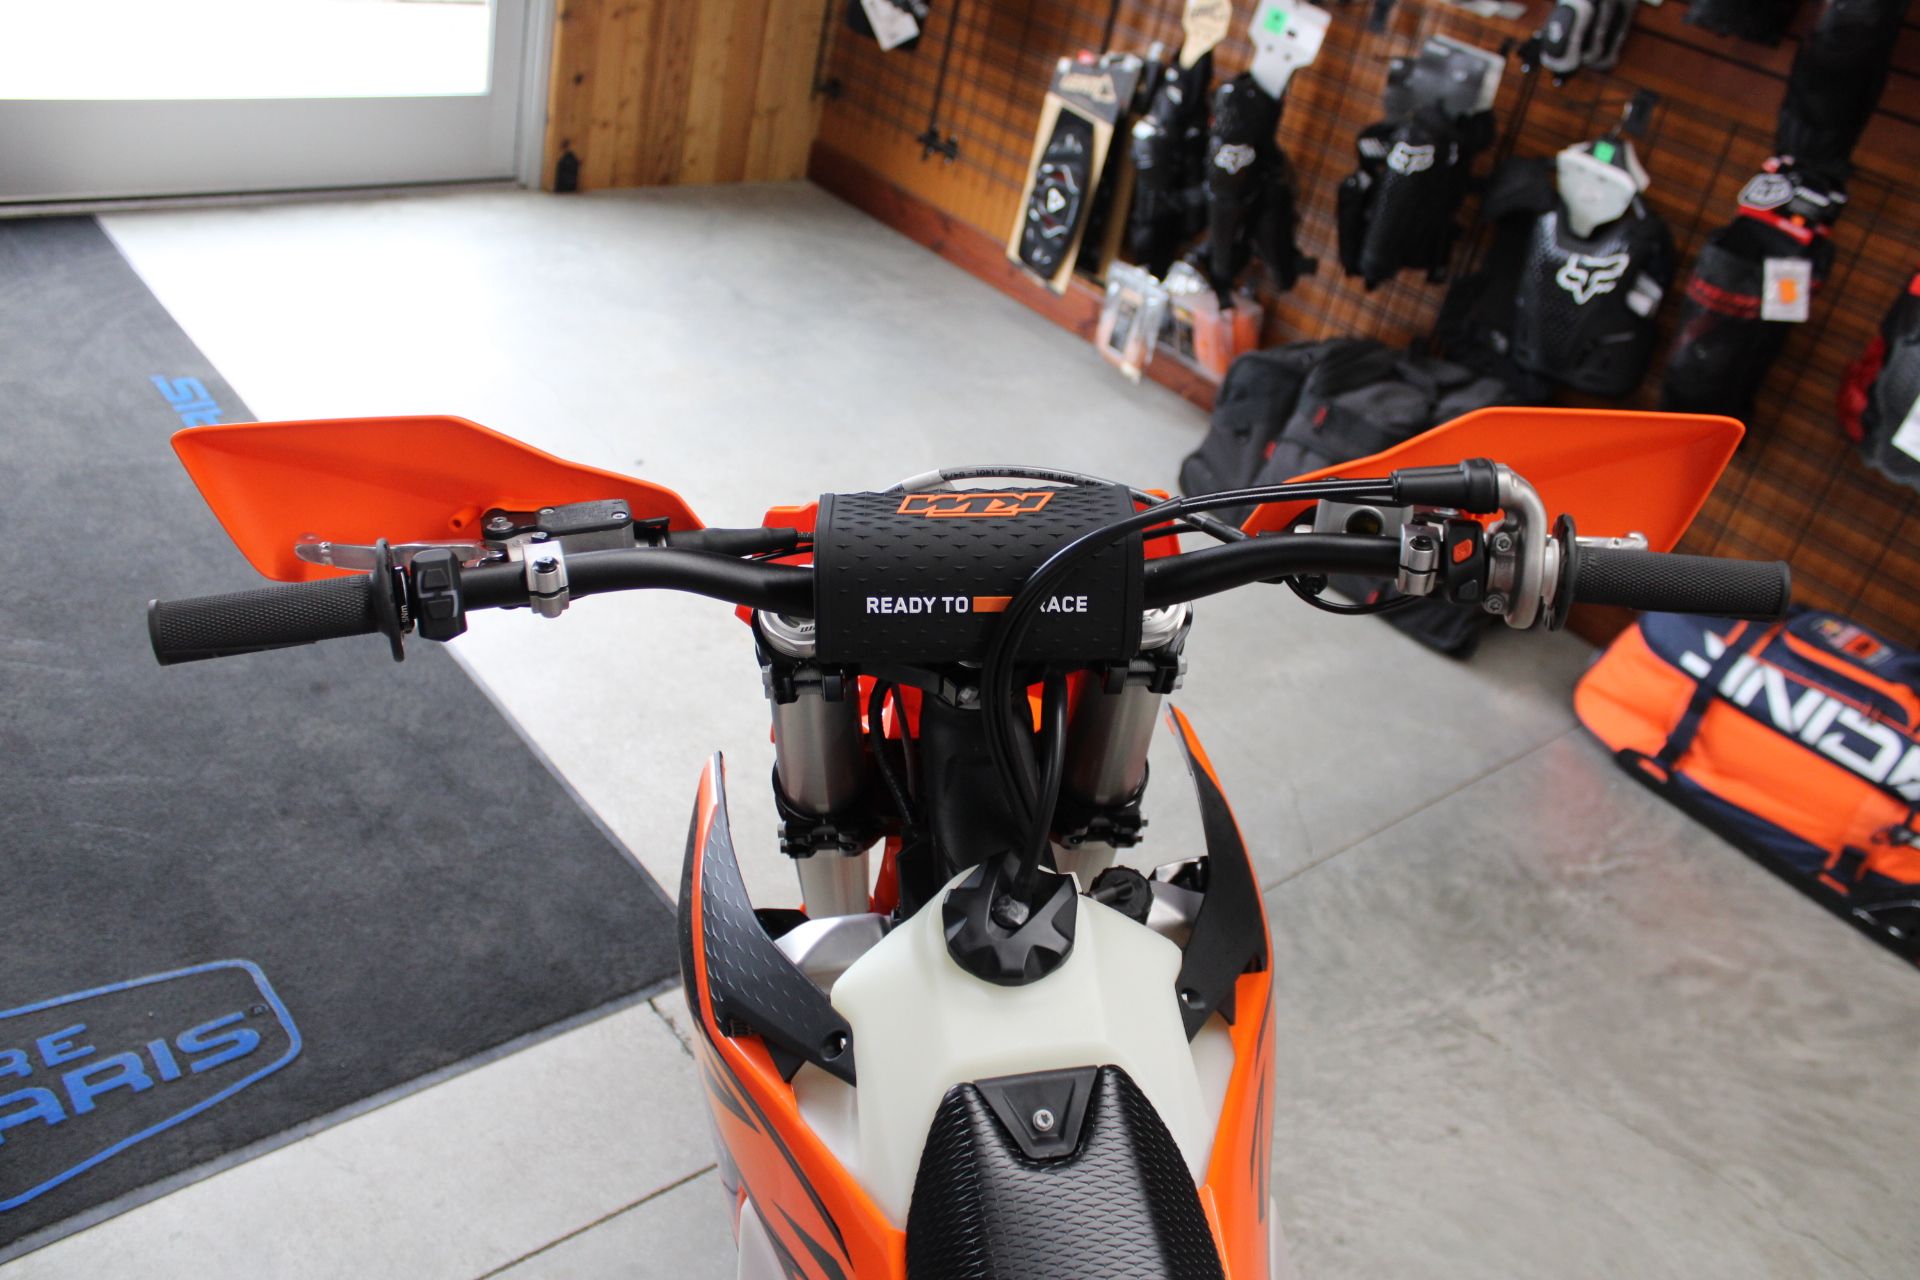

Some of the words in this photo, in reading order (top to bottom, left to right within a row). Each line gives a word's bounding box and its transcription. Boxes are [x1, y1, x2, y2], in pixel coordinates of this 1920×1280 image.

[897, 491, 1055, 518] KTM
[866, 596, 936, 614] READY
[942, 596, 969, 614] TO
[0, 1010, 260, 1148] ARIS
